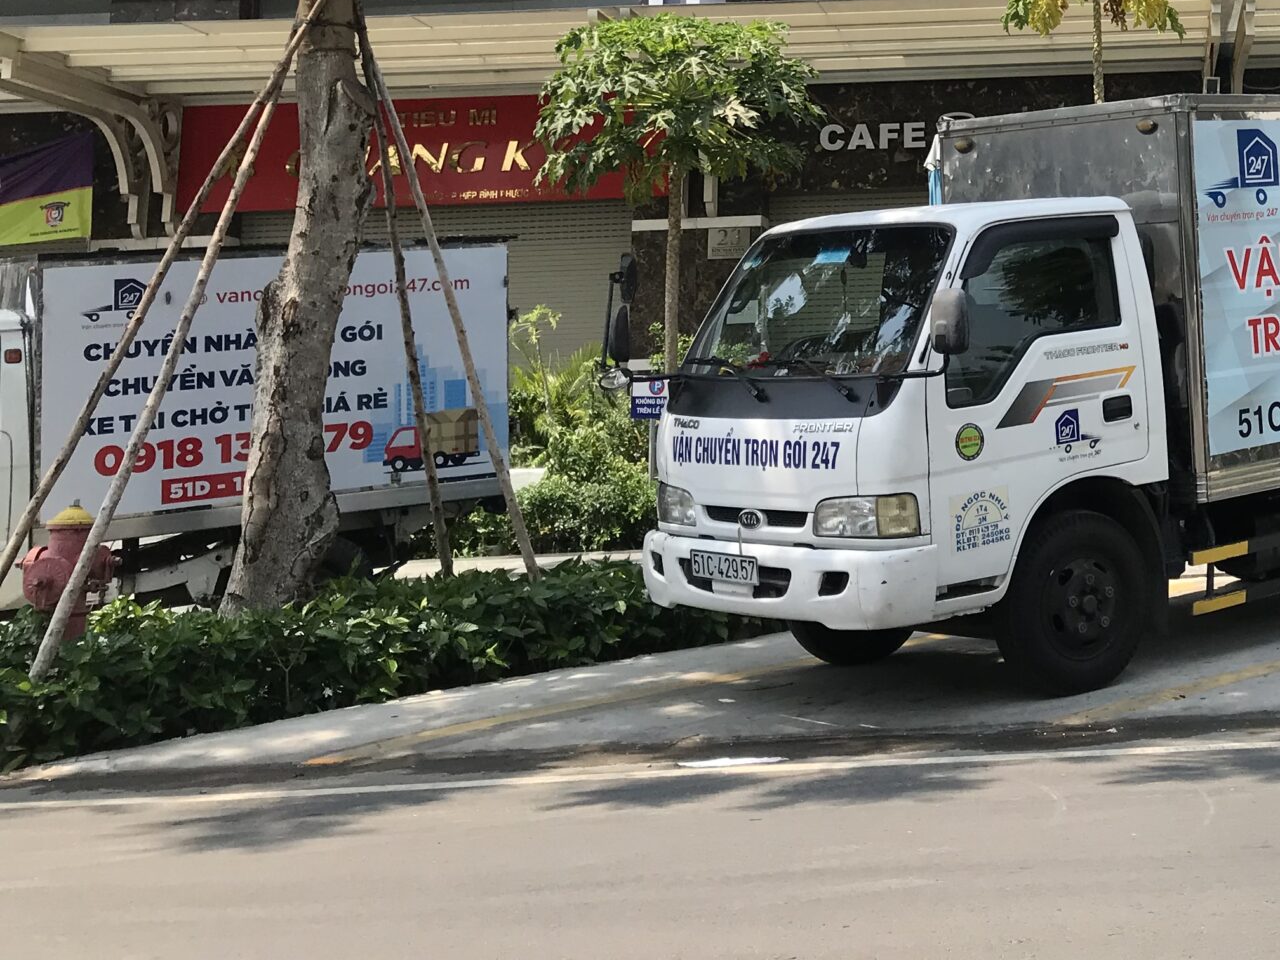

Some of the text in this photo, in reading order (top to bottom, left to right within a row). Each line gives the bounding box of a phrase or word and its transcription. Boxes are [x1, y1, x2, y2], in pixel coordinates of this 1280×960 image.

[820, 122, 926, 151] CAFE
[285, 141, 489, 176] ANG
[1249, 155, 1268, 176] 247
[1266, 208, 1279, 217] 247
[122, 292, 140, 304] 247
[204, 328, 258, 353] NHÀ
[341, 321, 383, 342] GÓI
[219, 363, 252, 387] VĂ
[85, 415, 114, 436] XE
[119, 411, 165, 434] TI
[171, 401, 229, 428] CHỞ
[322, 391, 351, 413] IÁ
[357, 387, 388, 411] RẺ
[793, 422, 854, 434] FRONTIER
[1061, 425, 1073, 437] 247
[94, 420, 374, 476] 0918 13 79
[673, 427, 840, 471] VẬN CHUYỂN TRỌN GÓI 247
[169, 481, 210, 499] 51D
[741, 515, 757, 525] KIA
